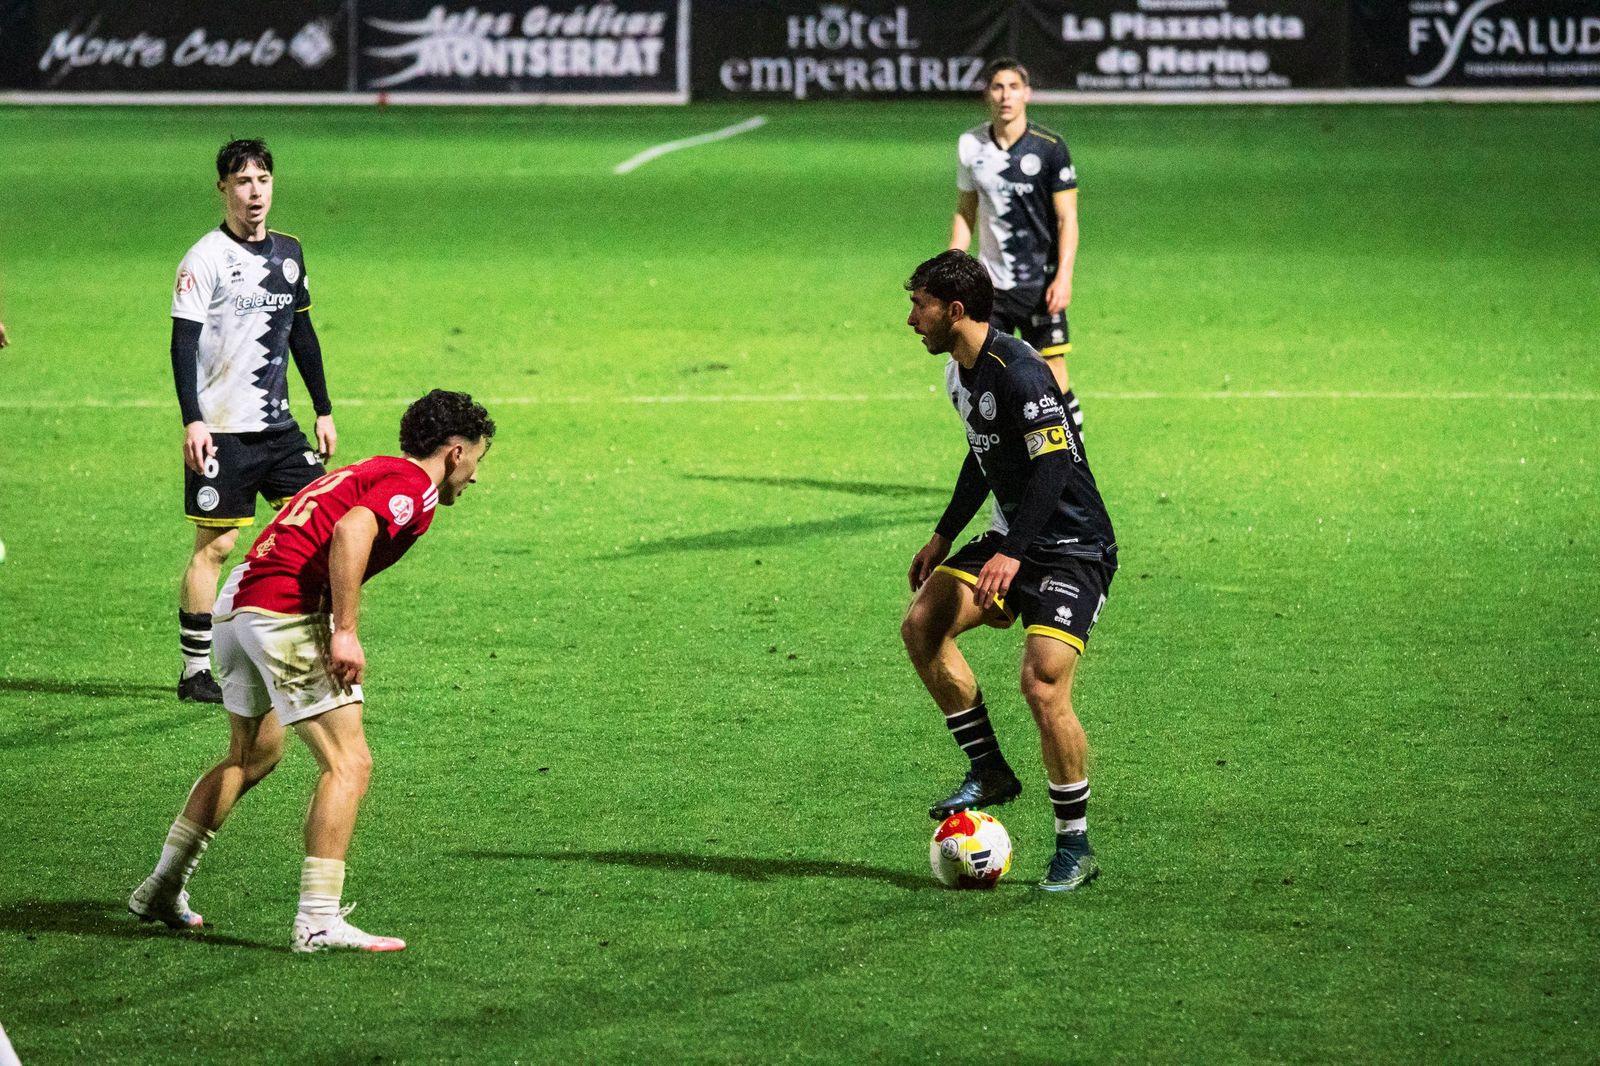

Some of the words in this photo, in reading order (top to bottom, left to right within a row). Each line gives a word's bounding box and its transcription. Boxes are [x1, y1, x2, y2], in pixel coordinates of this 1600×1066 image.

[1062, 13, 1105, 42] La
[38, 29, 167, 71] Monte
[172, 27, 285, 67] Carlo
[417, 37, 665, 77] MONTSERRAT
[1146, 45, 1270, 75] Merino
[1046, 428, 1063, 445] C
